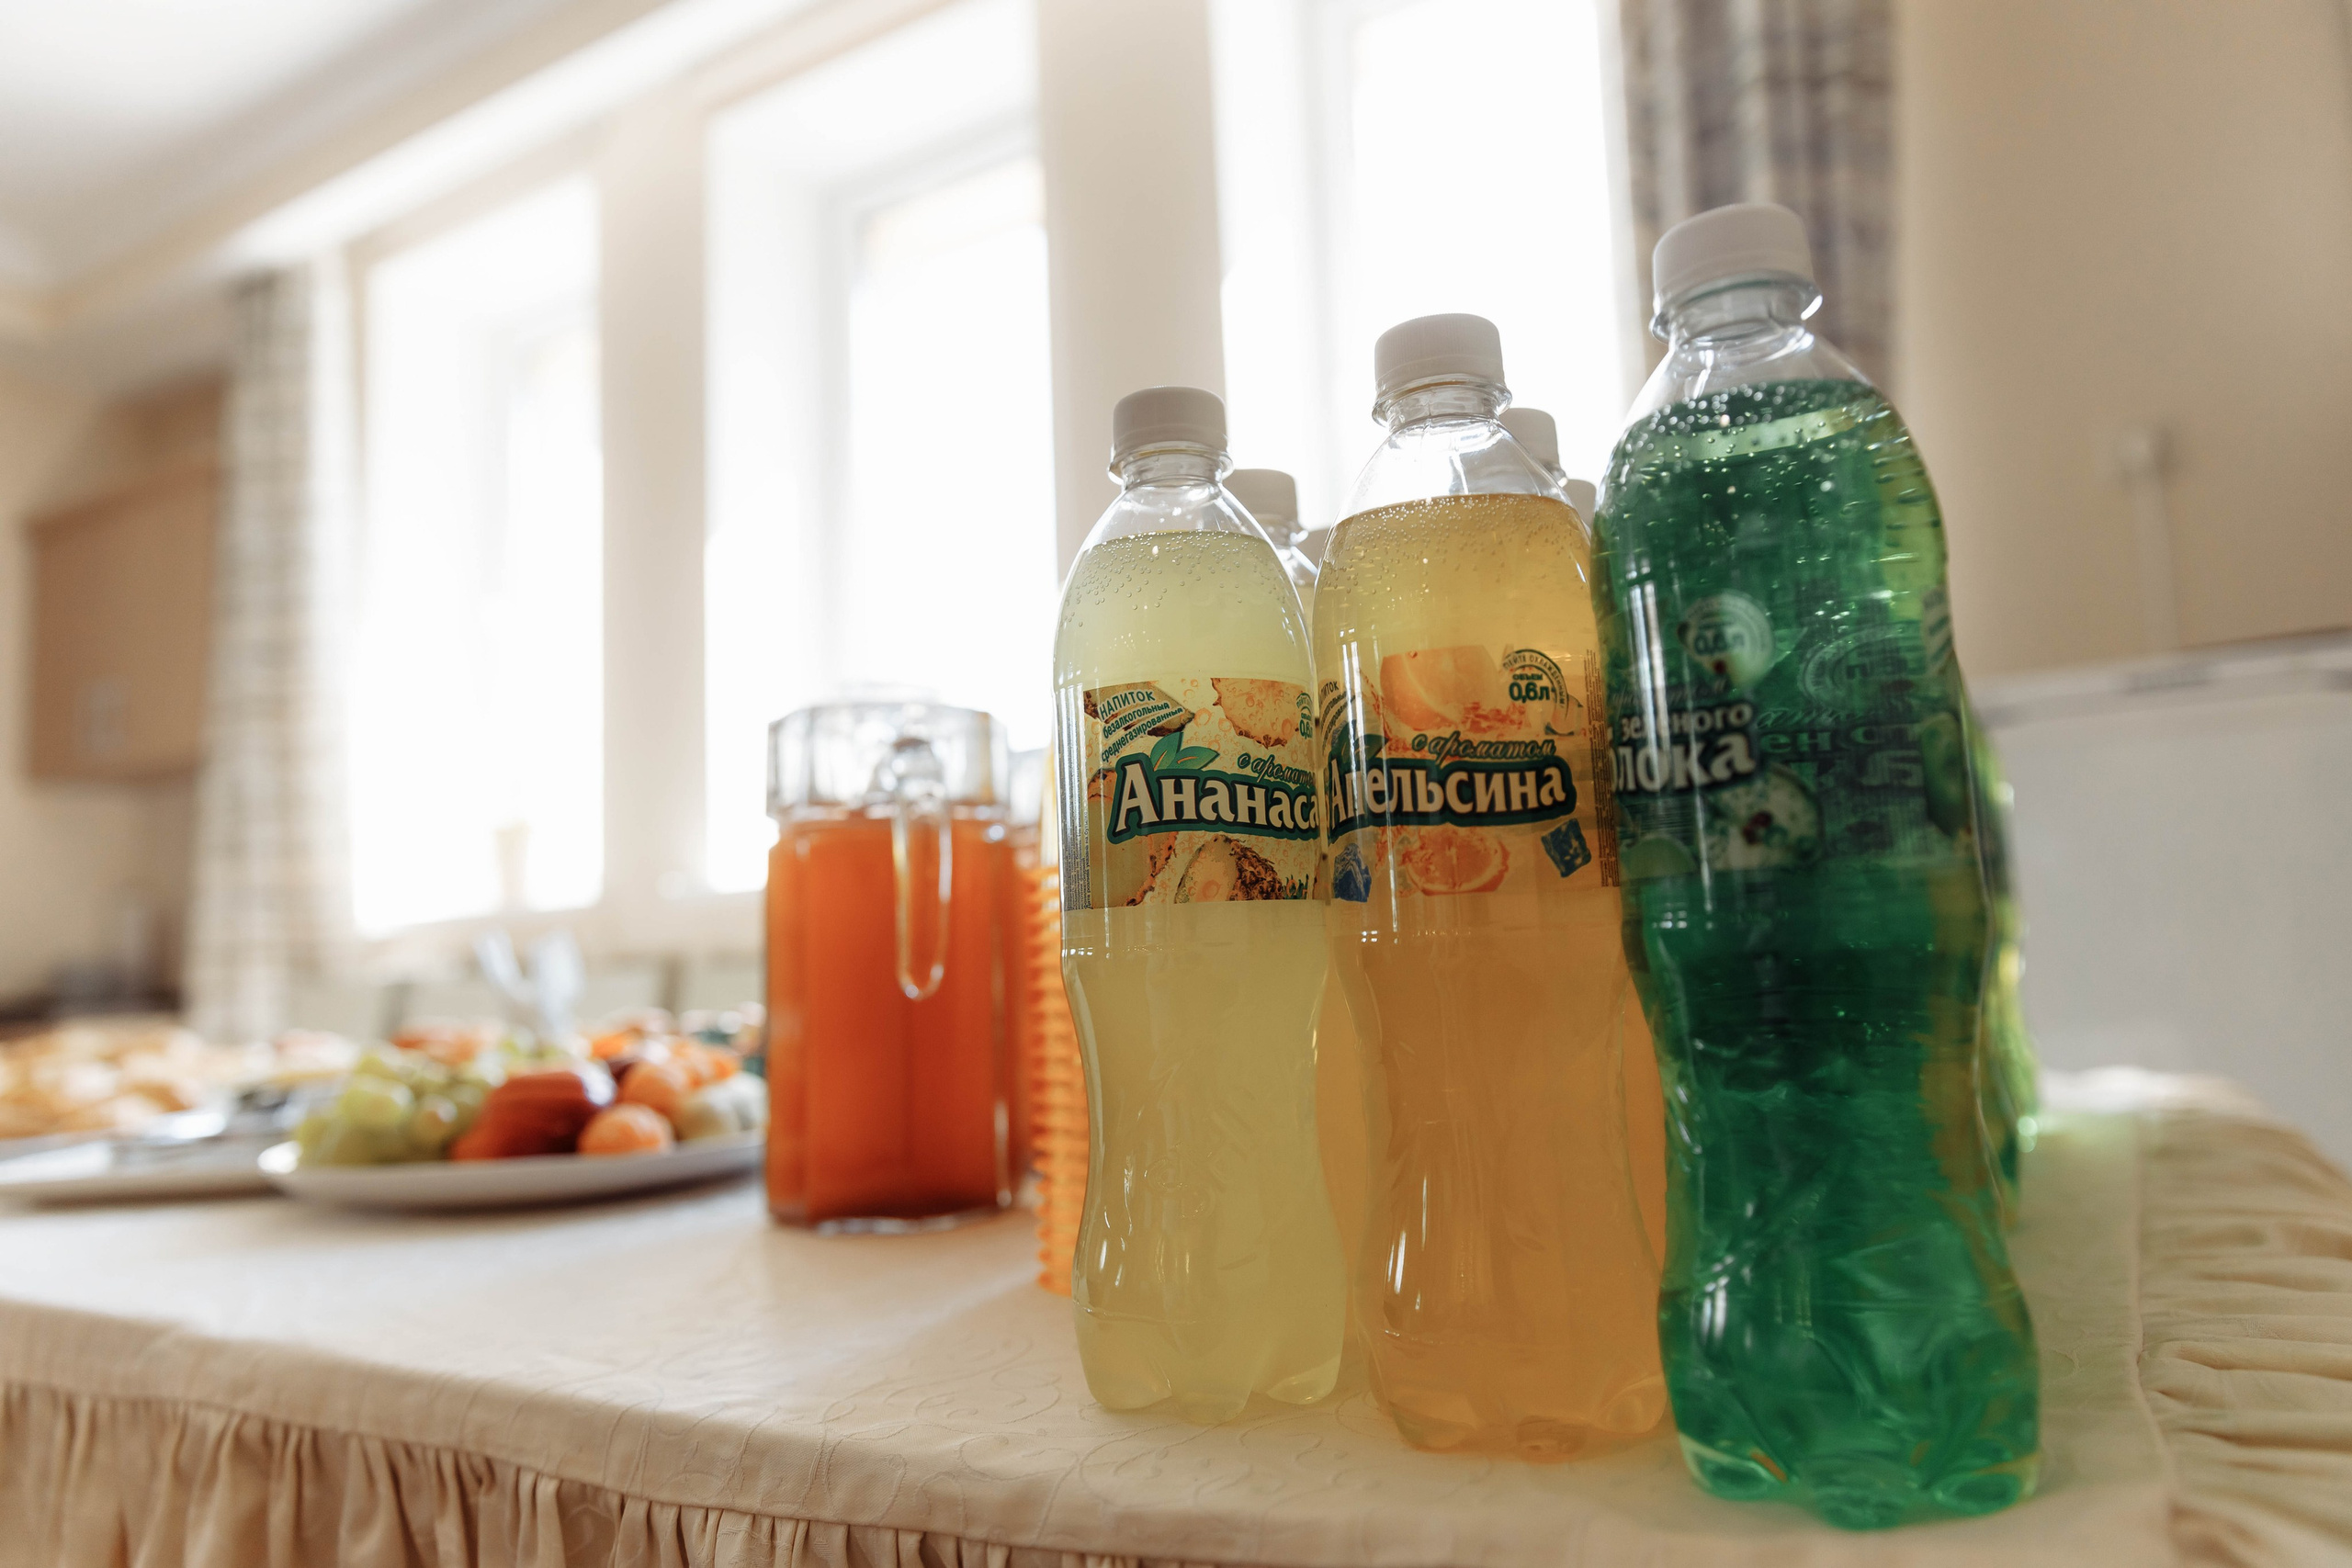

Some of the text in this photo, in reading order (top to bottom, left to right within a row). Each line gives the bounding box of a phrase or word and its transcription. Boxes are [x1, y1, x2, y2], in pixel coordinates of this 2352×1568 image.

[1100, 691, 1156, 720] НАПИТОК
[1509, 682, 1550, 704] 0,6л
[1102, 707, 1183, 762] среднегазированный
[1103, 702, 1170, 739] безалкогольный
[1621, 703, 1754, 742] зеного
[1429, 730, 1557, 765] ароматом
[1114, 761, 1320, 831] Ананаса
[1330, 757, 1567, 830] Апельсина
